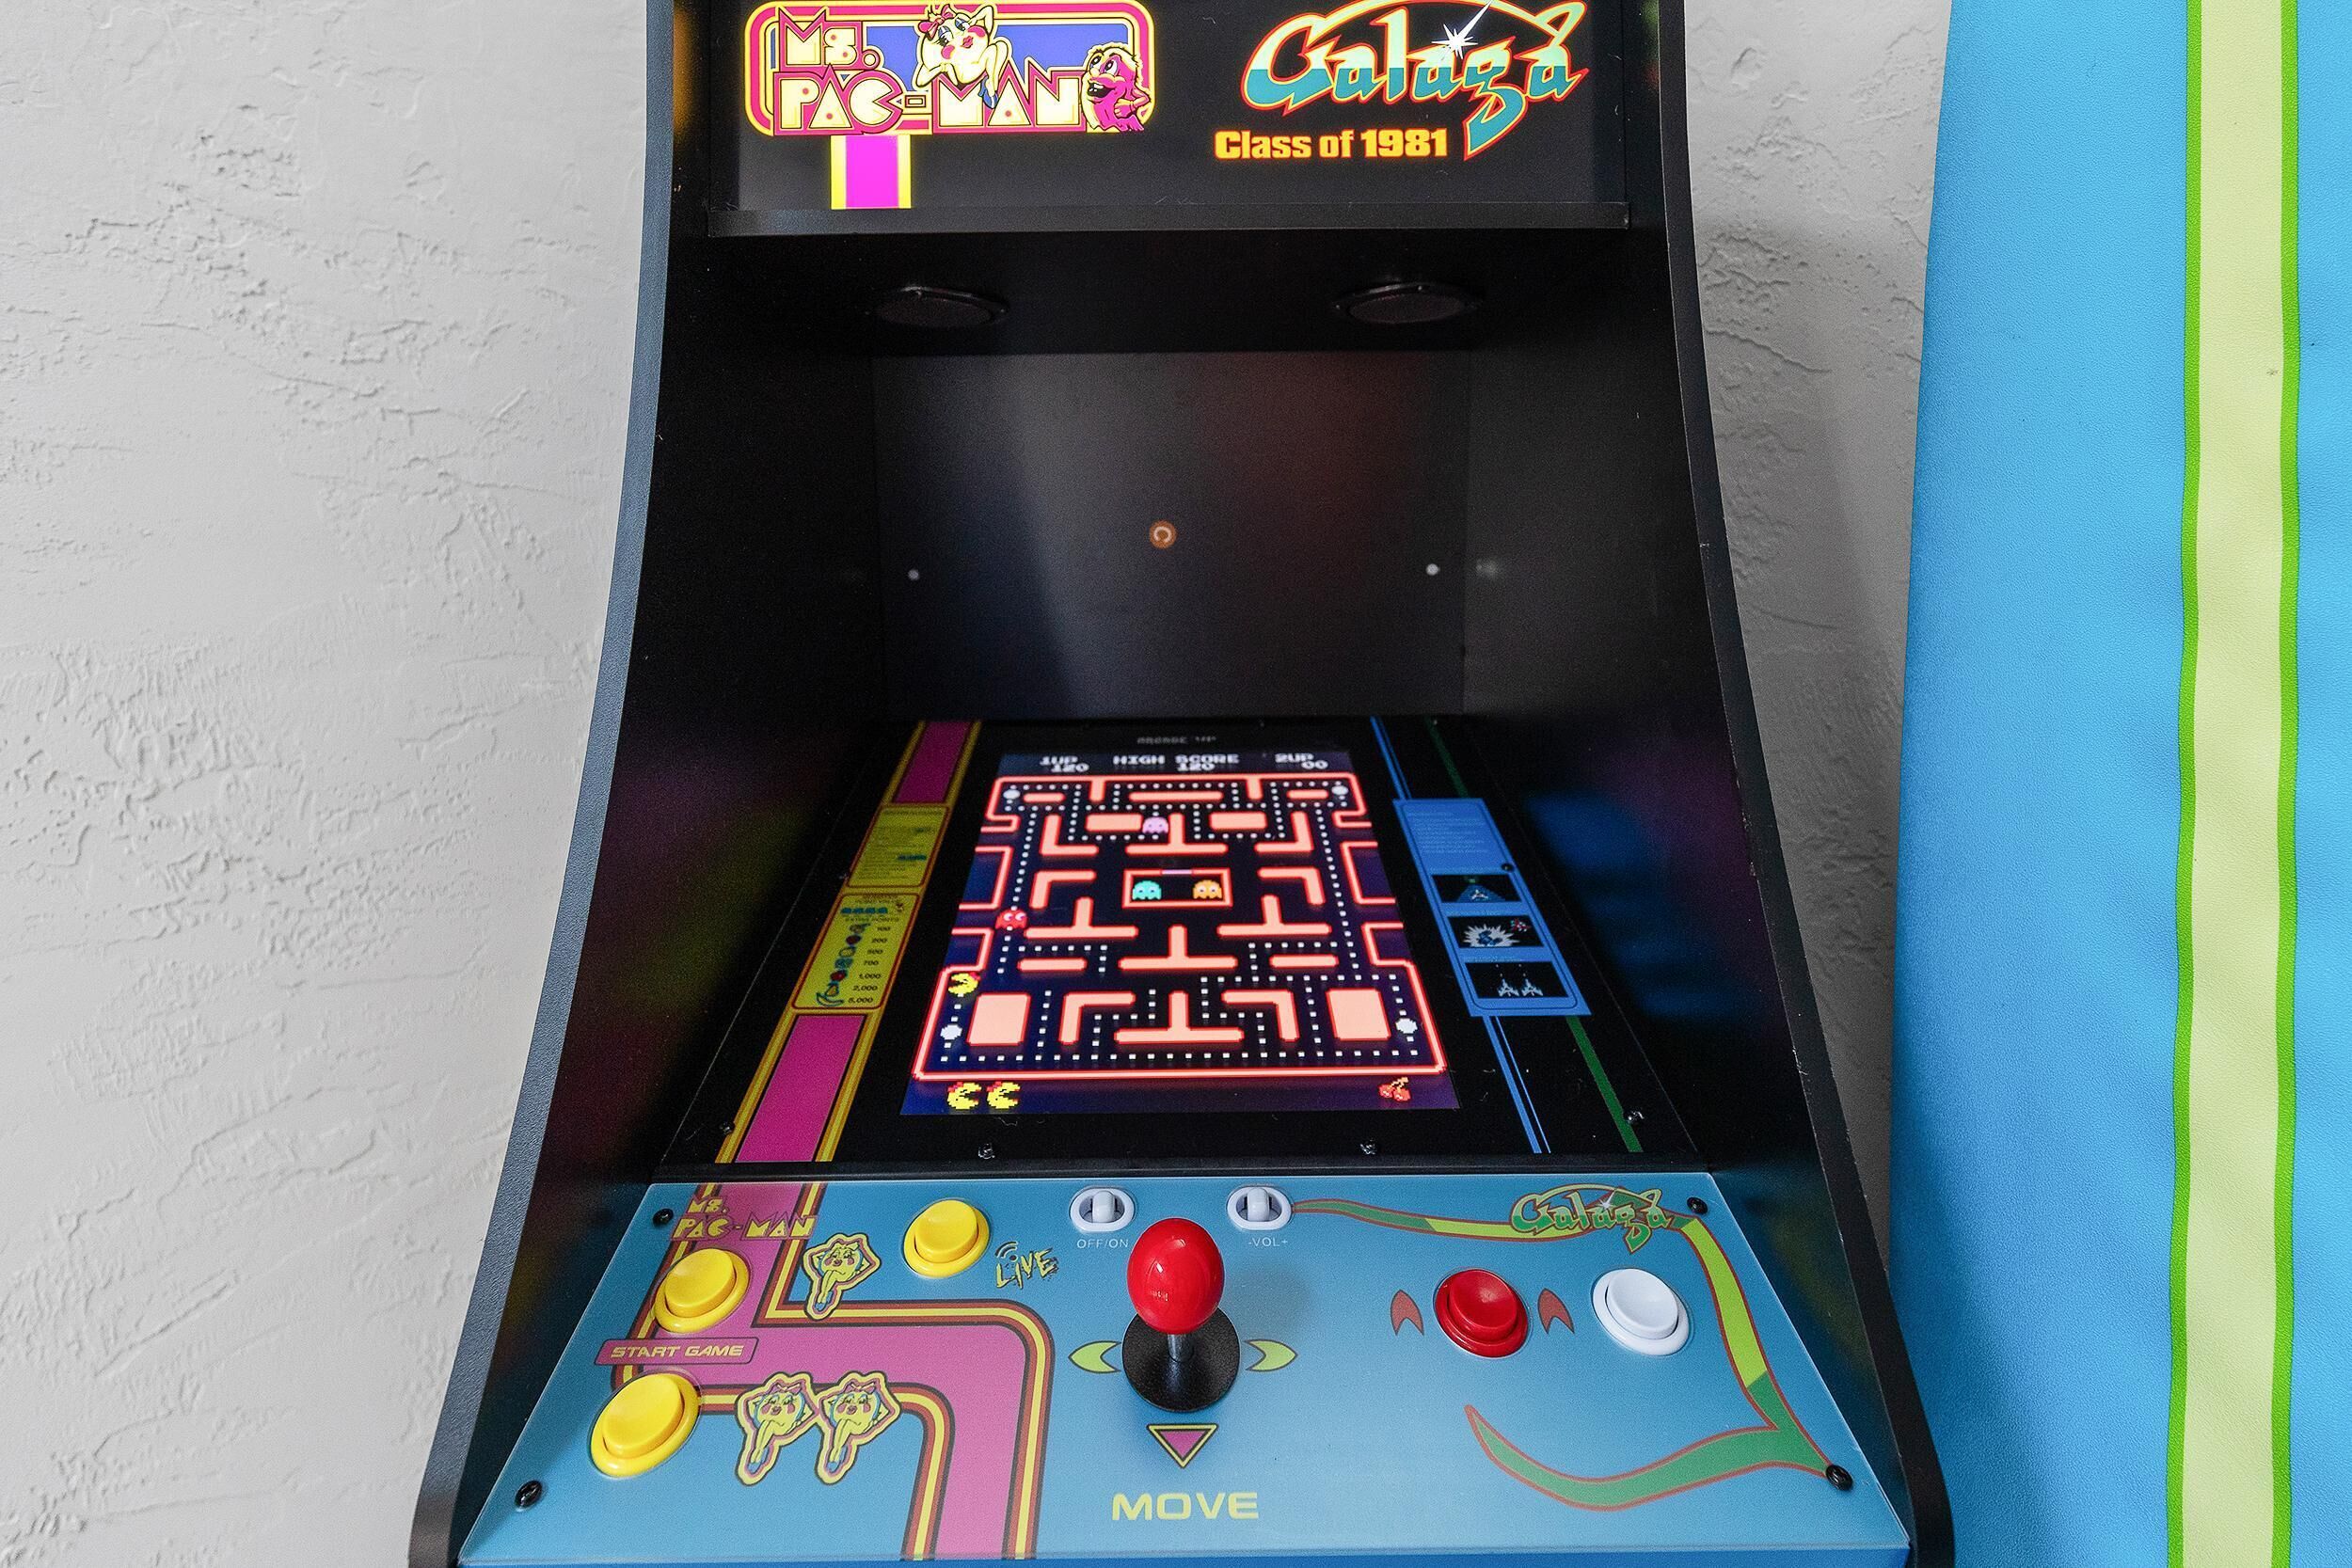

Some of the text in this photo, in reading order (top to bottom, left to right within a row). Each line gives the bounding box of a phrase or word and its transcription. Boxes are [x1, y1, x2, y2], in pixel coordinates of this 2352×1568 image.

[1215, 127, 1448, 160] Class of 1981
[1113, 753, 1239, 765] HIGH SCORE
[672, 1213, 818, 1240] PAC-MAN
[1076, 1238, 1128, 1249] OFF/ON
[611, 1344, 745, 1358] START GAME
[1112, 1492, 1260, 1521] MOVE
